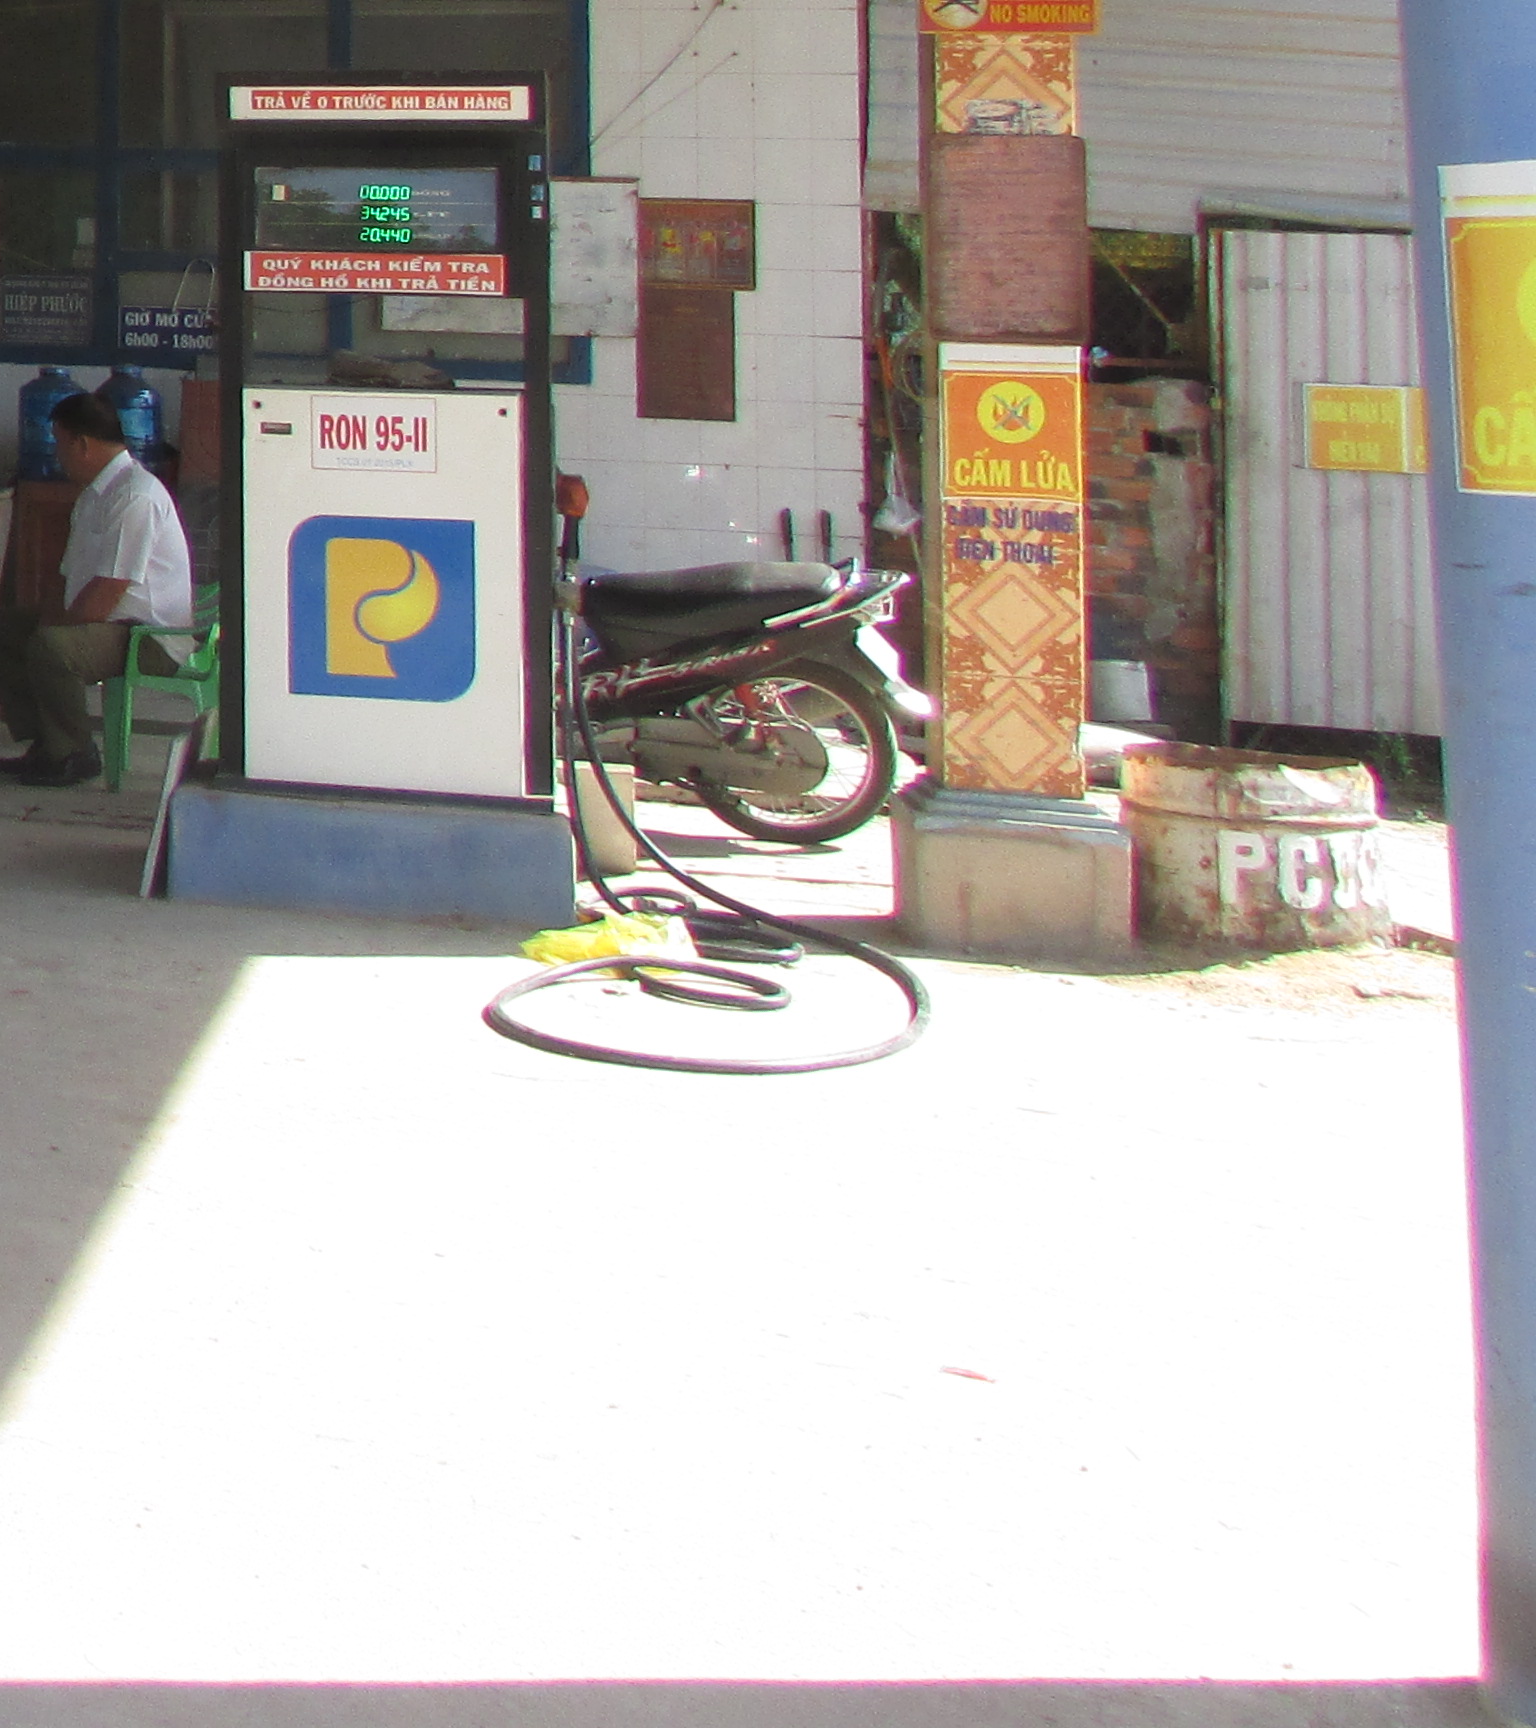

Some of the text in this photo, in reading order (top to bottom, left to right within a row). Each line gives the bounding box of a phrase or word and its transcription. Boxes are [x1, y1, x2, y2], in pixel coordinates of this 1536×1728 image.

[990, 4, 1091, 23] NO SMOKING
[254, 92, 286, 109] TRẢ
[292, 91, 310, 109] VỀ
[333, 92, 386, 109] TRƯỚC
[391, 97, 419, 109] KHI
[426, 93, 459, 109] BÁN
[463, 93, 509, 110] HÀNG
[263, 256, 490, 273] QUÝ KHÁCH KIỂM TRA
[257, 274, 496, 292] ĐỒNG HỒ KHI TRẢ TIỀN
[124, 332, 158, 348] 6h00
[319, 414, 428, 452] RON 95-II
[954, 447, 1077, 493] CẤM LỬA
